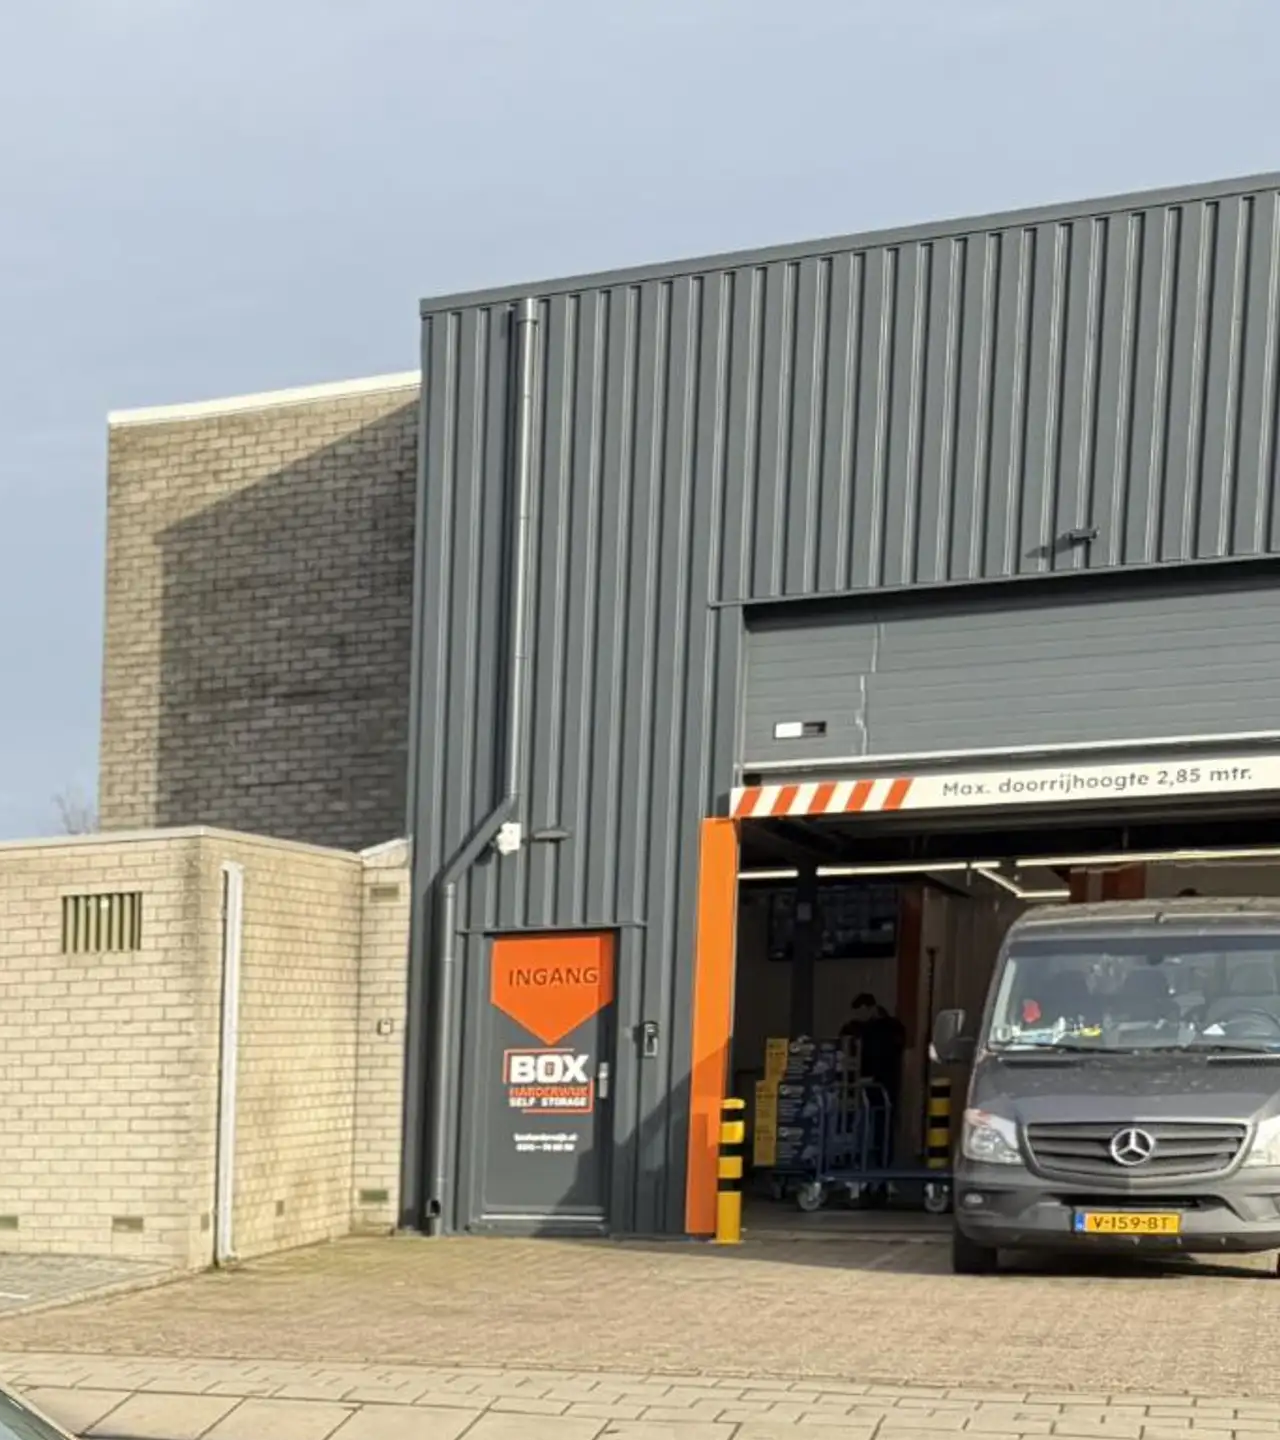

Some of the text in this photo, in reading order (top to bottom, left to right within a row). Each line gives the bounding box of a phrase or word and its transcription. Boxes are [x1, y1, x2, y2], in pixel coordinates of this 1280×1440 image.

[942, 767, 1253, 797] Max. doorrijhoogte 2,85 mtr.
[508, 967, 599, 987] INGANG
[510, 1054, 589, 1083] BOX
[509, 1097, 587, 1107] SELF STORAGE
